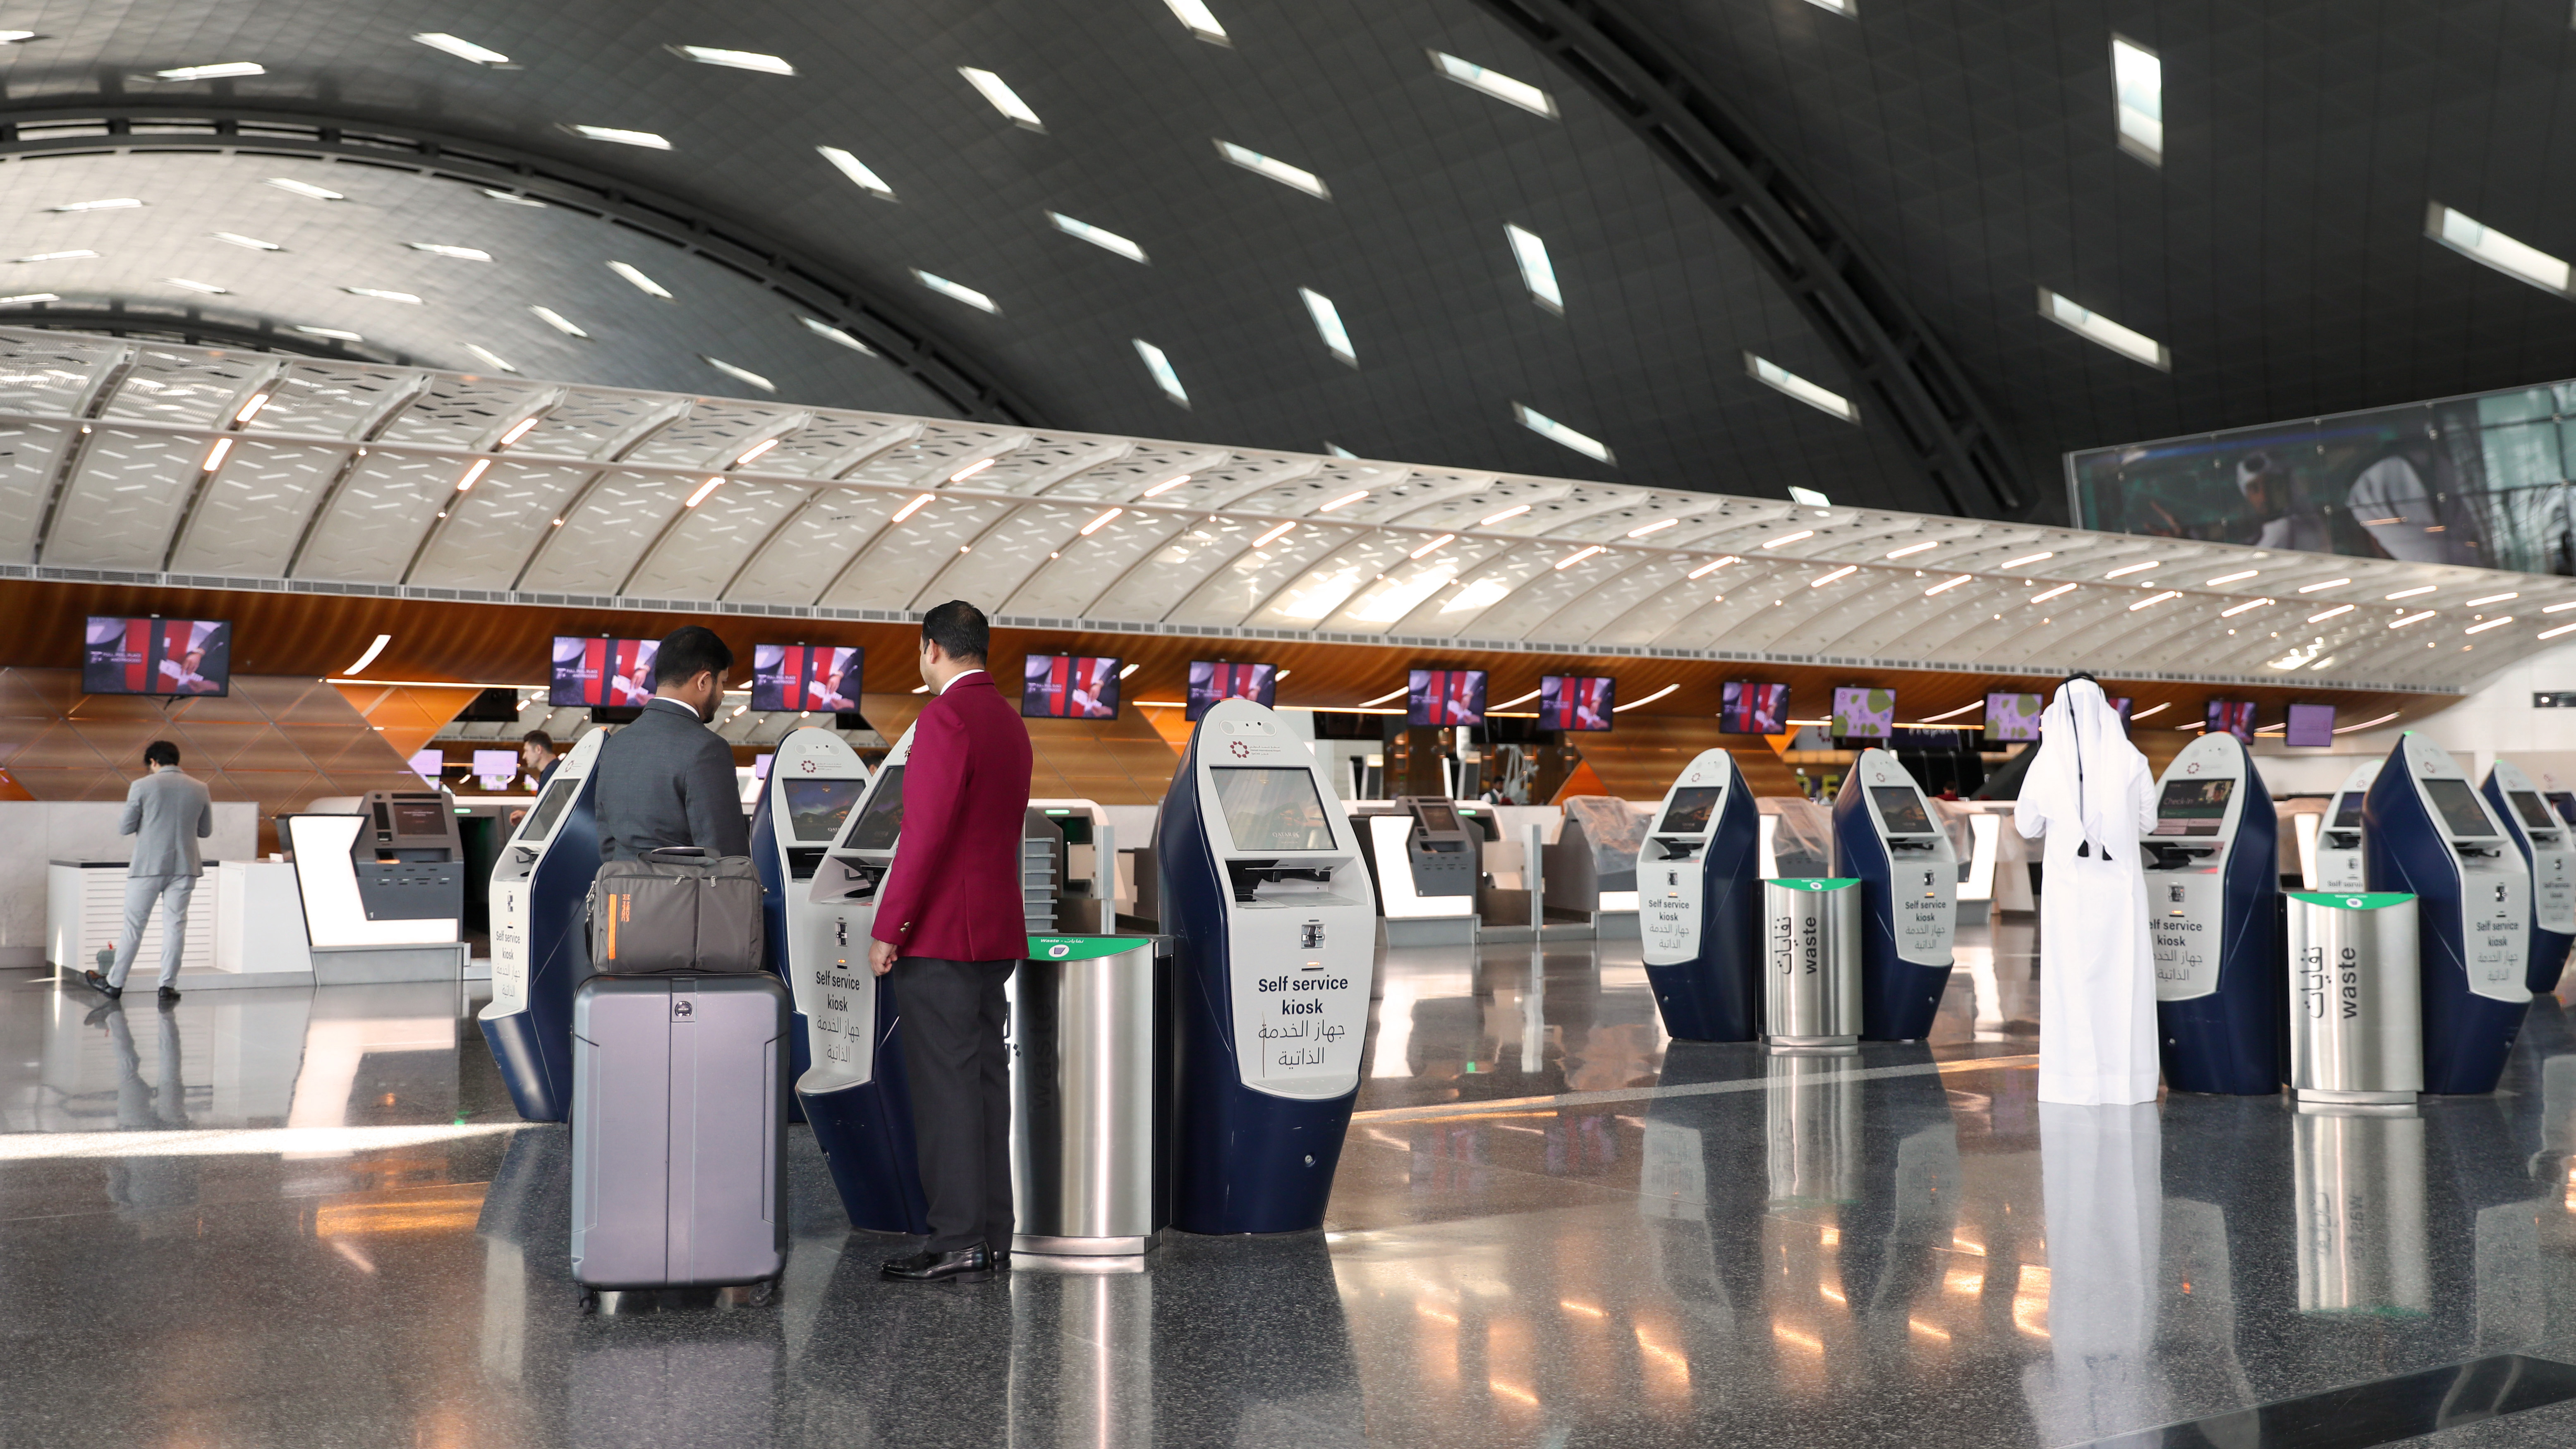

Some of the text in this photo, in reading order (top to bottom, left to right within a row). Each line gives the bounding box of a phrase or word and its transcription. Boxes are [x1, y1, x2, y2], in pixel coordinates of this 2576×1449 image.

[1649, 899, 1689, 908] Self service
[1905, 900, 1946, 909] Self service
[1659, 912, 1678, 921] kiosk
[1916, 913, 1934, 921] kiosk
[2149, 919, 2202, 931] elf service
[2476, 920, 2518, 931] Self service
[505, 932, 520, 944] service
[1774, 917, 1798, 974] نفايات
[1803, 917, 1817, 974] waste
[2157, 934, 2185, 946] kiosk
[2488, 936, 2507, 946] kiosk
[502, 947, 514, 960] kiosk
[2181, 950, 2202, 967] جهاز
[816, 970, 860, 990] Self service
[1258, 975, 1348, 992] Self service
[2157, 968, 2188, 982] الذاتية
[2299, 947, 2331, 1018] نفايات
[2338, 947, 2357, 1019] waste
[828, 994, 848, 1012] kiosk
[1282, 998, 1323, 1015] kiosk
[817, 1015, 860, 1043] جهاز الخدمة
[1259, 1019, 1345, 1042] جهاز الخدمة
[827, 1044, 850, 1063] الذاتية
[1030, 1004, 1052, 1111] waste
[1278, 1047, 1324, 1069] الذاتية
